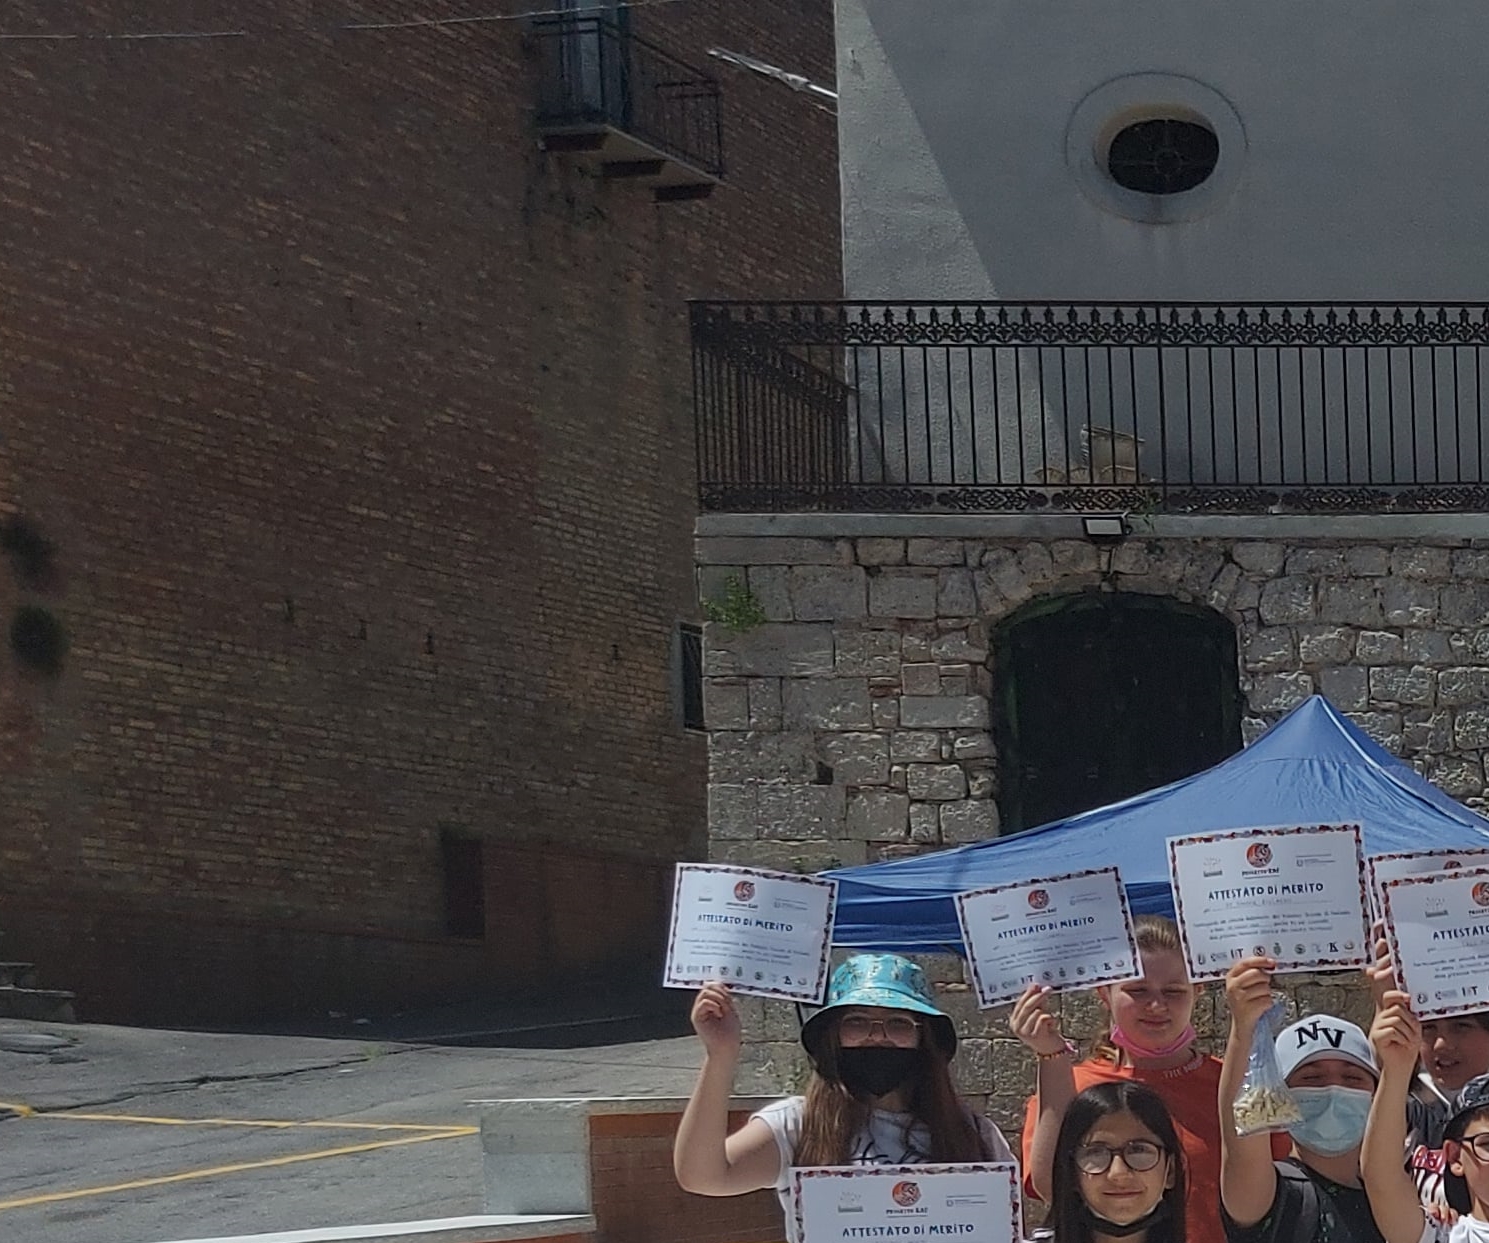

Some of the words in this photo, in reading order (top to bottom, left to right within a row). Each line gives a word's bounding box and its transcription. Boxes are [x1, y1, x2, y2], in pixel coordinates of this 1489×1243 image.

[1208, 885, 1264, 901] ATTESTATO
[697, 914, 741, 925] ATTESTATO
[997, 925, 1046, 940] ATTESTATO
[842, 1225, 911, 1238] ATTESTATO
